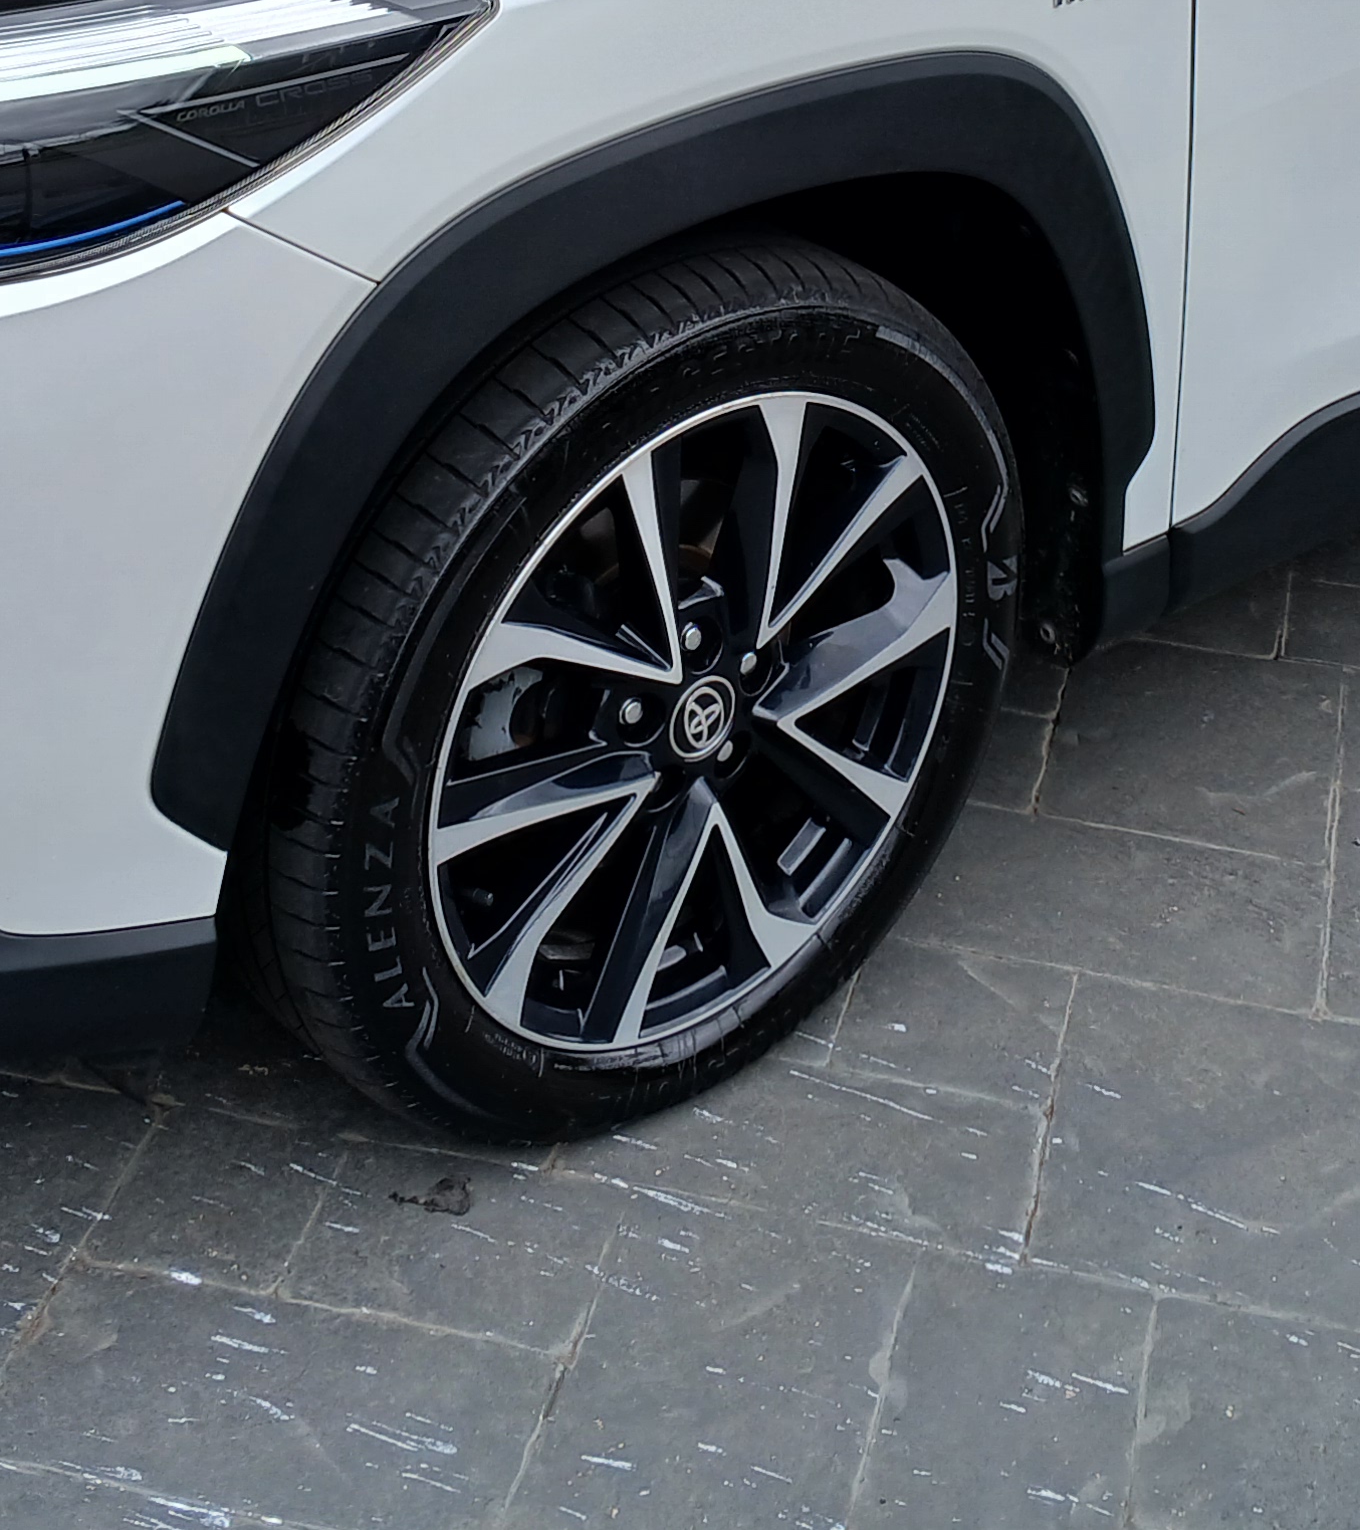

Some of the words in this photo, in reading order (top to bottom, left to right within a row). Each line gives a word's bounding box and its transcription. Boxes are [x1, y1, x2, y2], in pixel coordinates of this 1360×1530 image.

[176, 100, 246, 122] COROLLA
[254, 70, 373, 108] CROSS
[362, 797, 415, 1008] ALENZA
